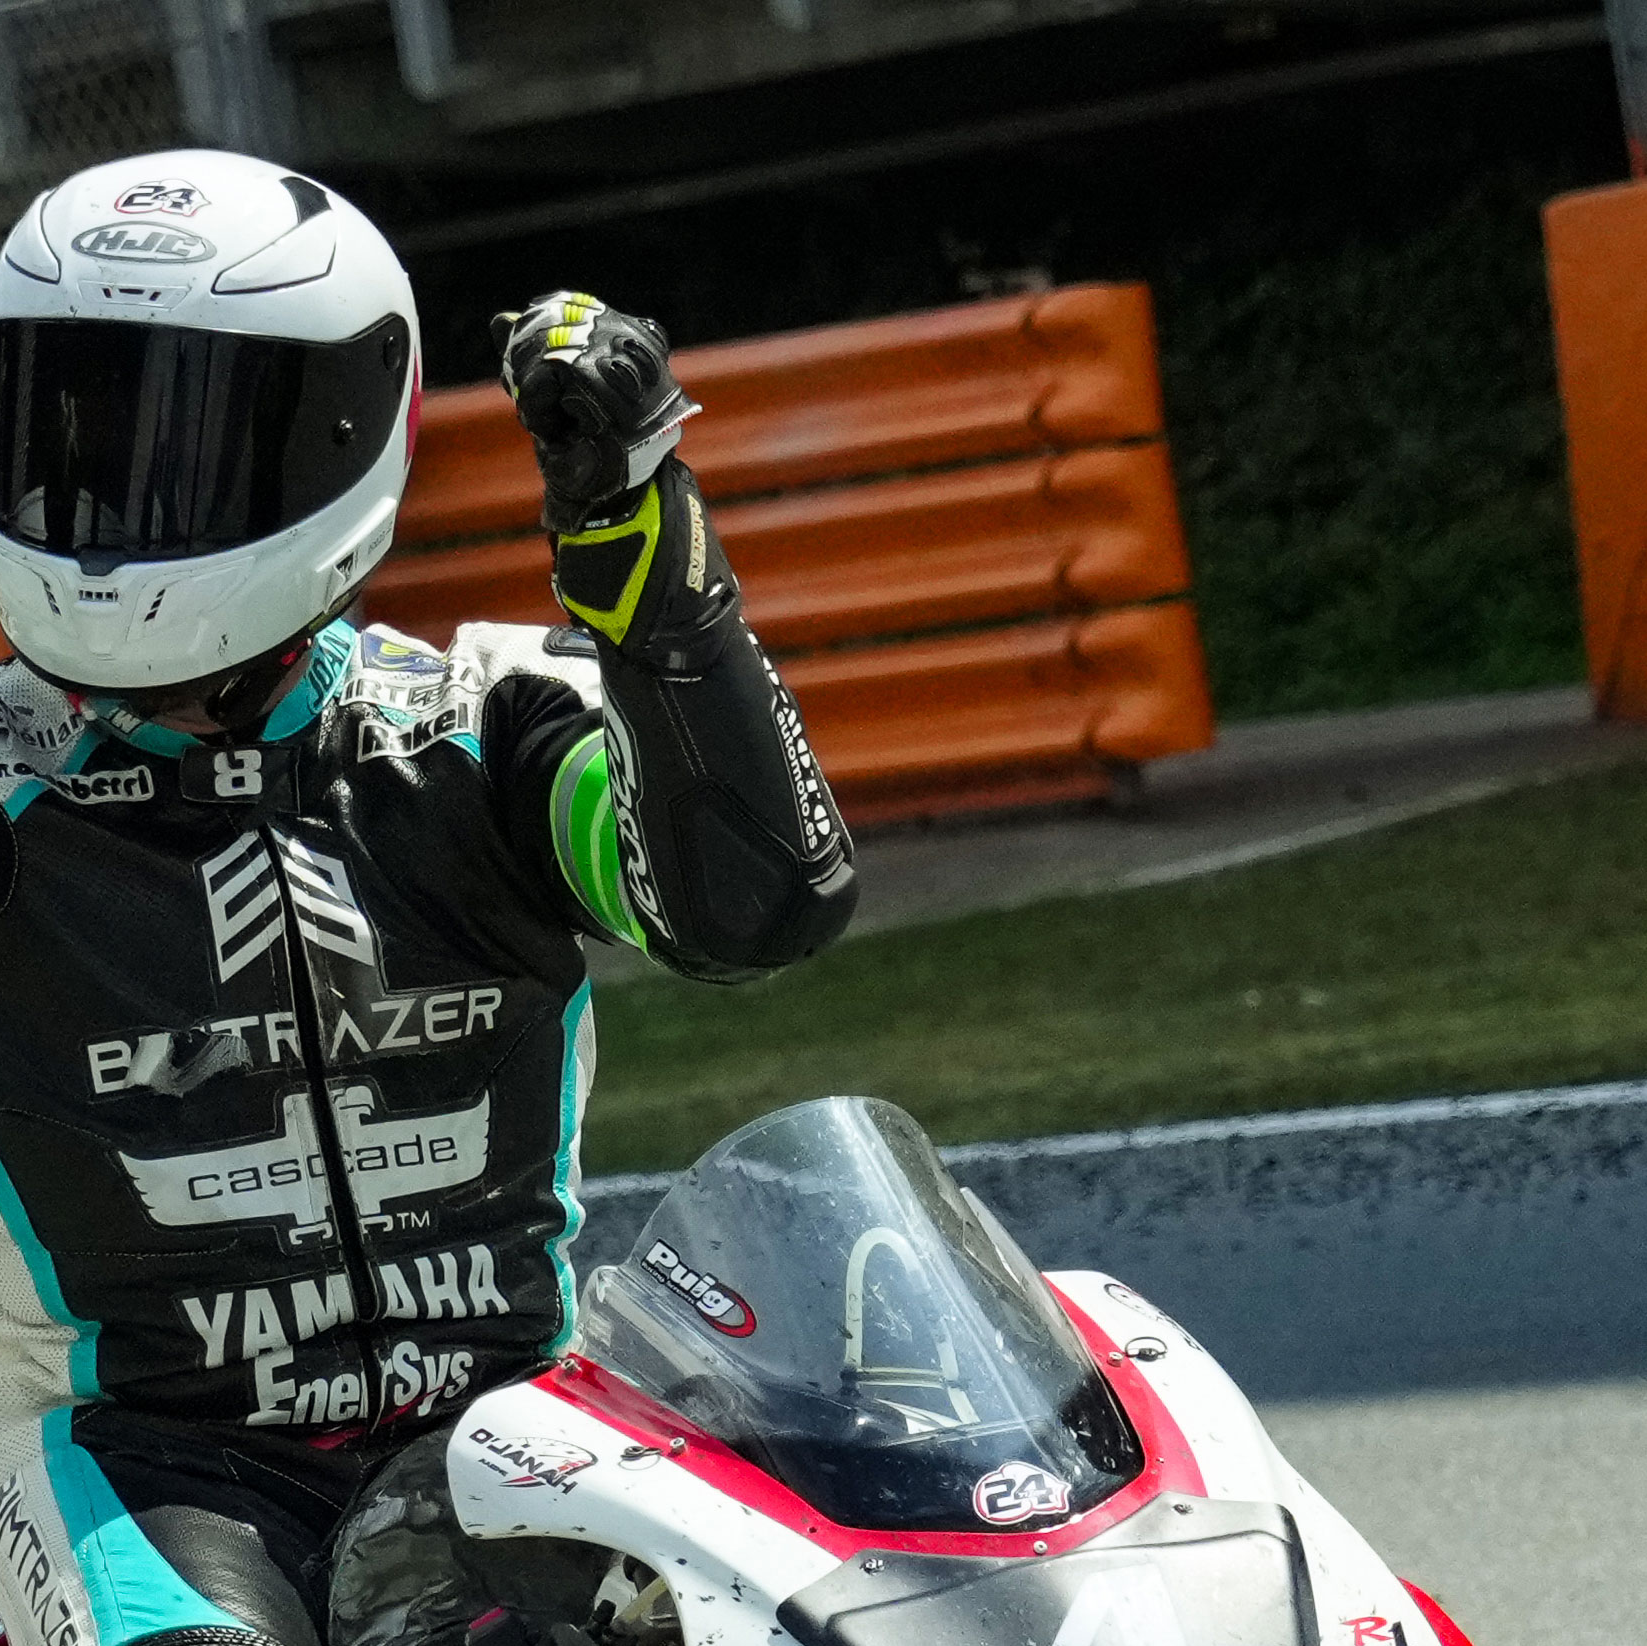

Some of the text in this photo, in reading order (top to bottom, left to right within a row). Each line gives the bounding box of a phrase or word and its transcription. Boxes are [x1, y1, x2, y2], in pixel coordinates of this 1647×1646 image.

[121, 184, 197, 211] 24
[89, 230, 202, 257] HJC
[213, 749, 263, 797] 8
[774, 709, 820, 851] automoto.es
[187, 1134, 458, 1201] cascade
[182, 1243, 510, 1369] YAMAHA
[645, 1240, 735, 1317] Puig
[983, 1472, 1054, 1516] 24
